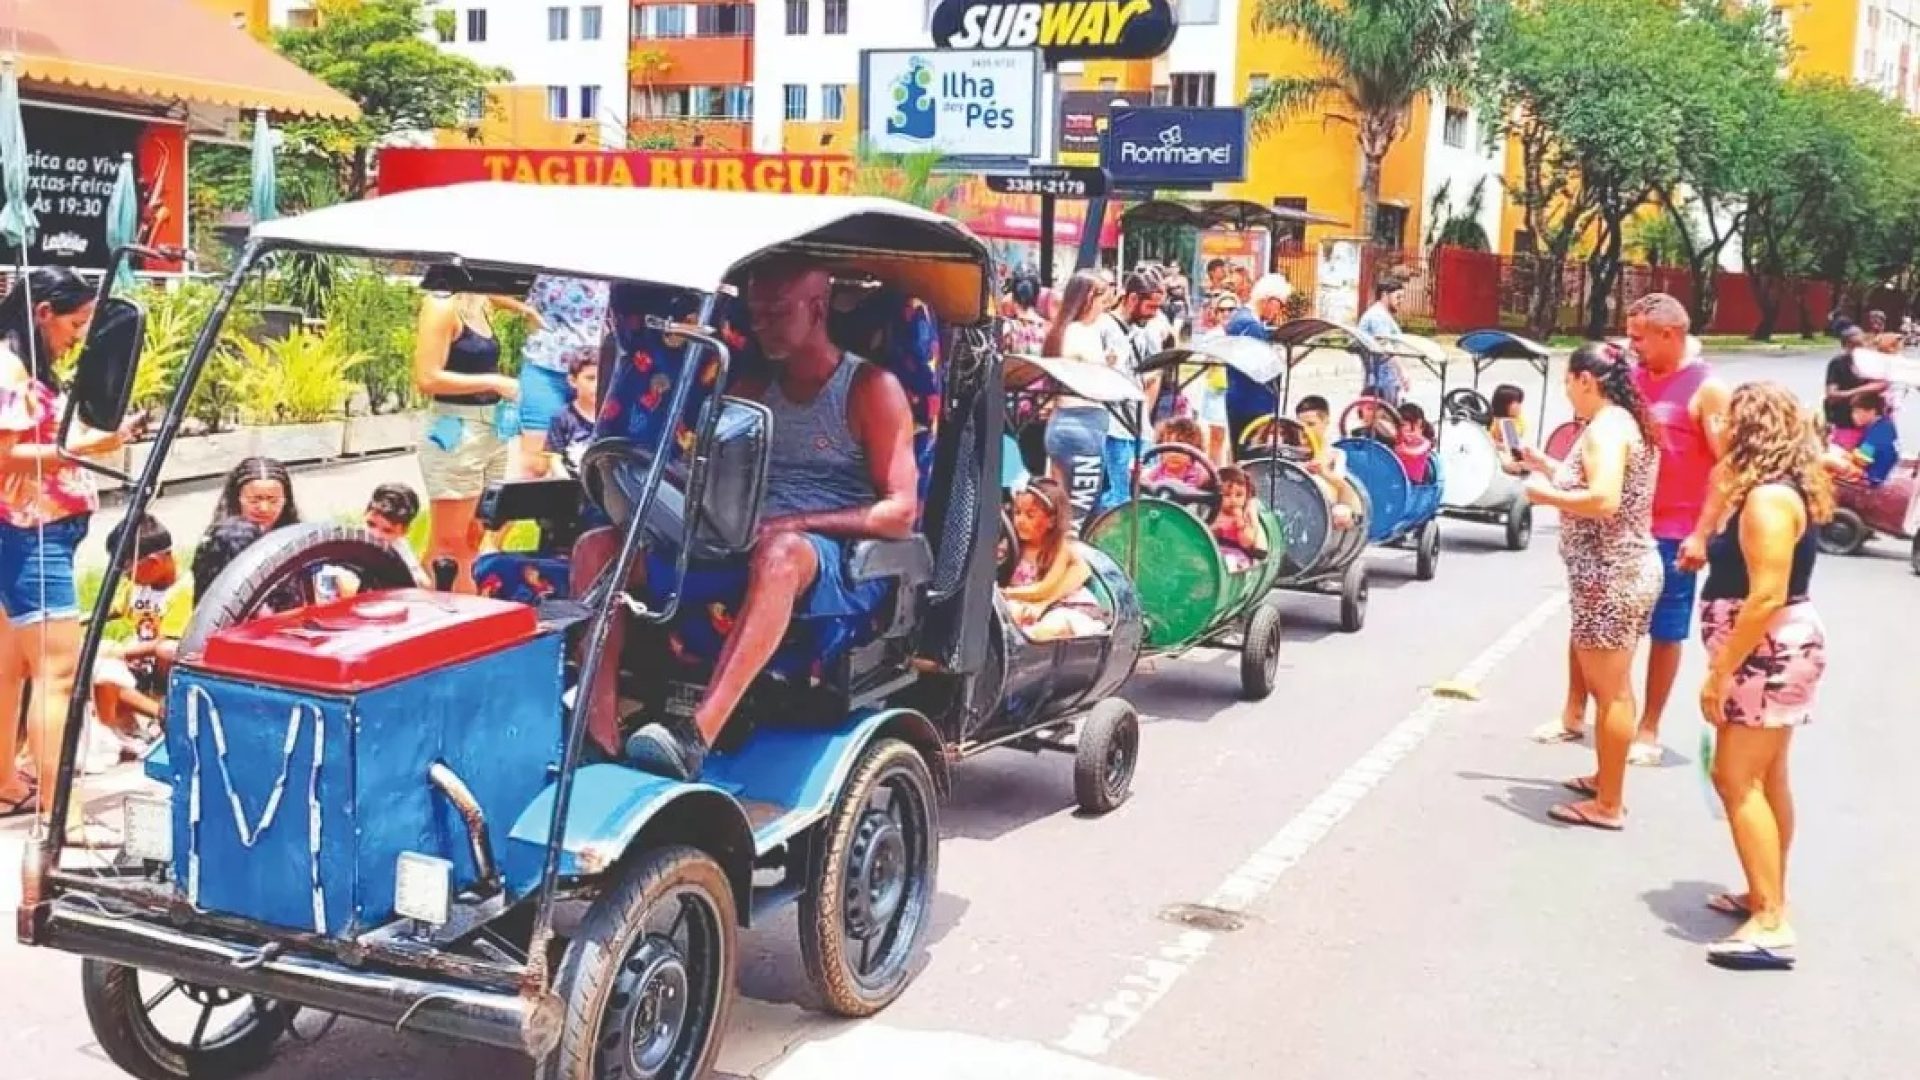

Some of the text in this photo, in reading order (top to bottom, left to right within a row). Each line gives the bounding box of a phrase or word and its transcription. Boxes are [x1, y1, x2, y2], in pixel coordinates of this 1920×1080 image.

[949, 1, 1152, 48] SUBWAY
[943, 71, 995, 98] Ilha
[966, 100, 1014, 129] Pés
[65, 157, 88, 172] ao
[92, 155, 121, 175] Viv
[1121, 142, 1231, 164] Rommanel
[483, 153, 856, 195] TAGUA BURGUE
[59, 197, 102, 217] 19:30
[1070, 455, 1101, 511] NEW
